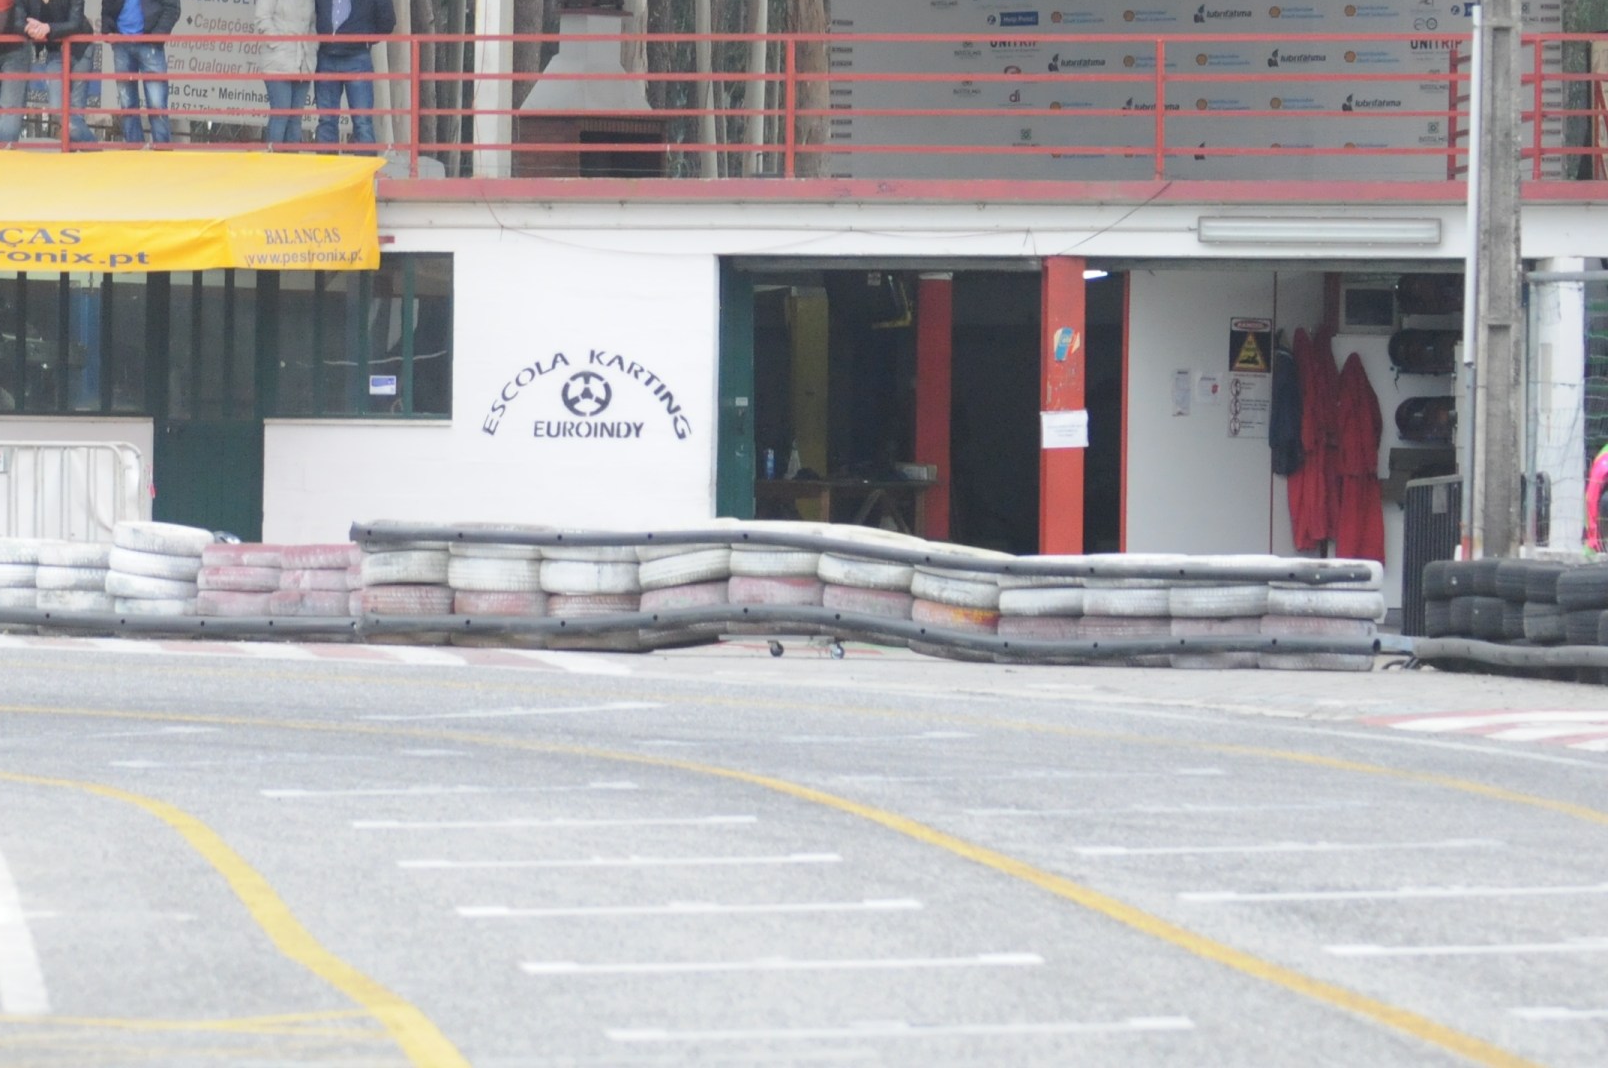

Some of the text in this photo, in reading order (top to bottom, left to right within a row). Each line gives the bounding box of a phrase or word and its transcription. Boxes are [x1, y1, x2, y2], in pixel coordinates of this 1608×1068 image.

[194, 13, 255, 34] Captações
[167, 55, 185, 70] Em
[183, 84, 208, 98] Cruz
[218, 87, 270, 103] Meirinhas
[264, 227, 342, 247] BALANÇAS
[482, 349, 692, 440] ESCOLA KARTING
[533, 420, 645, 438] EUROINDY
